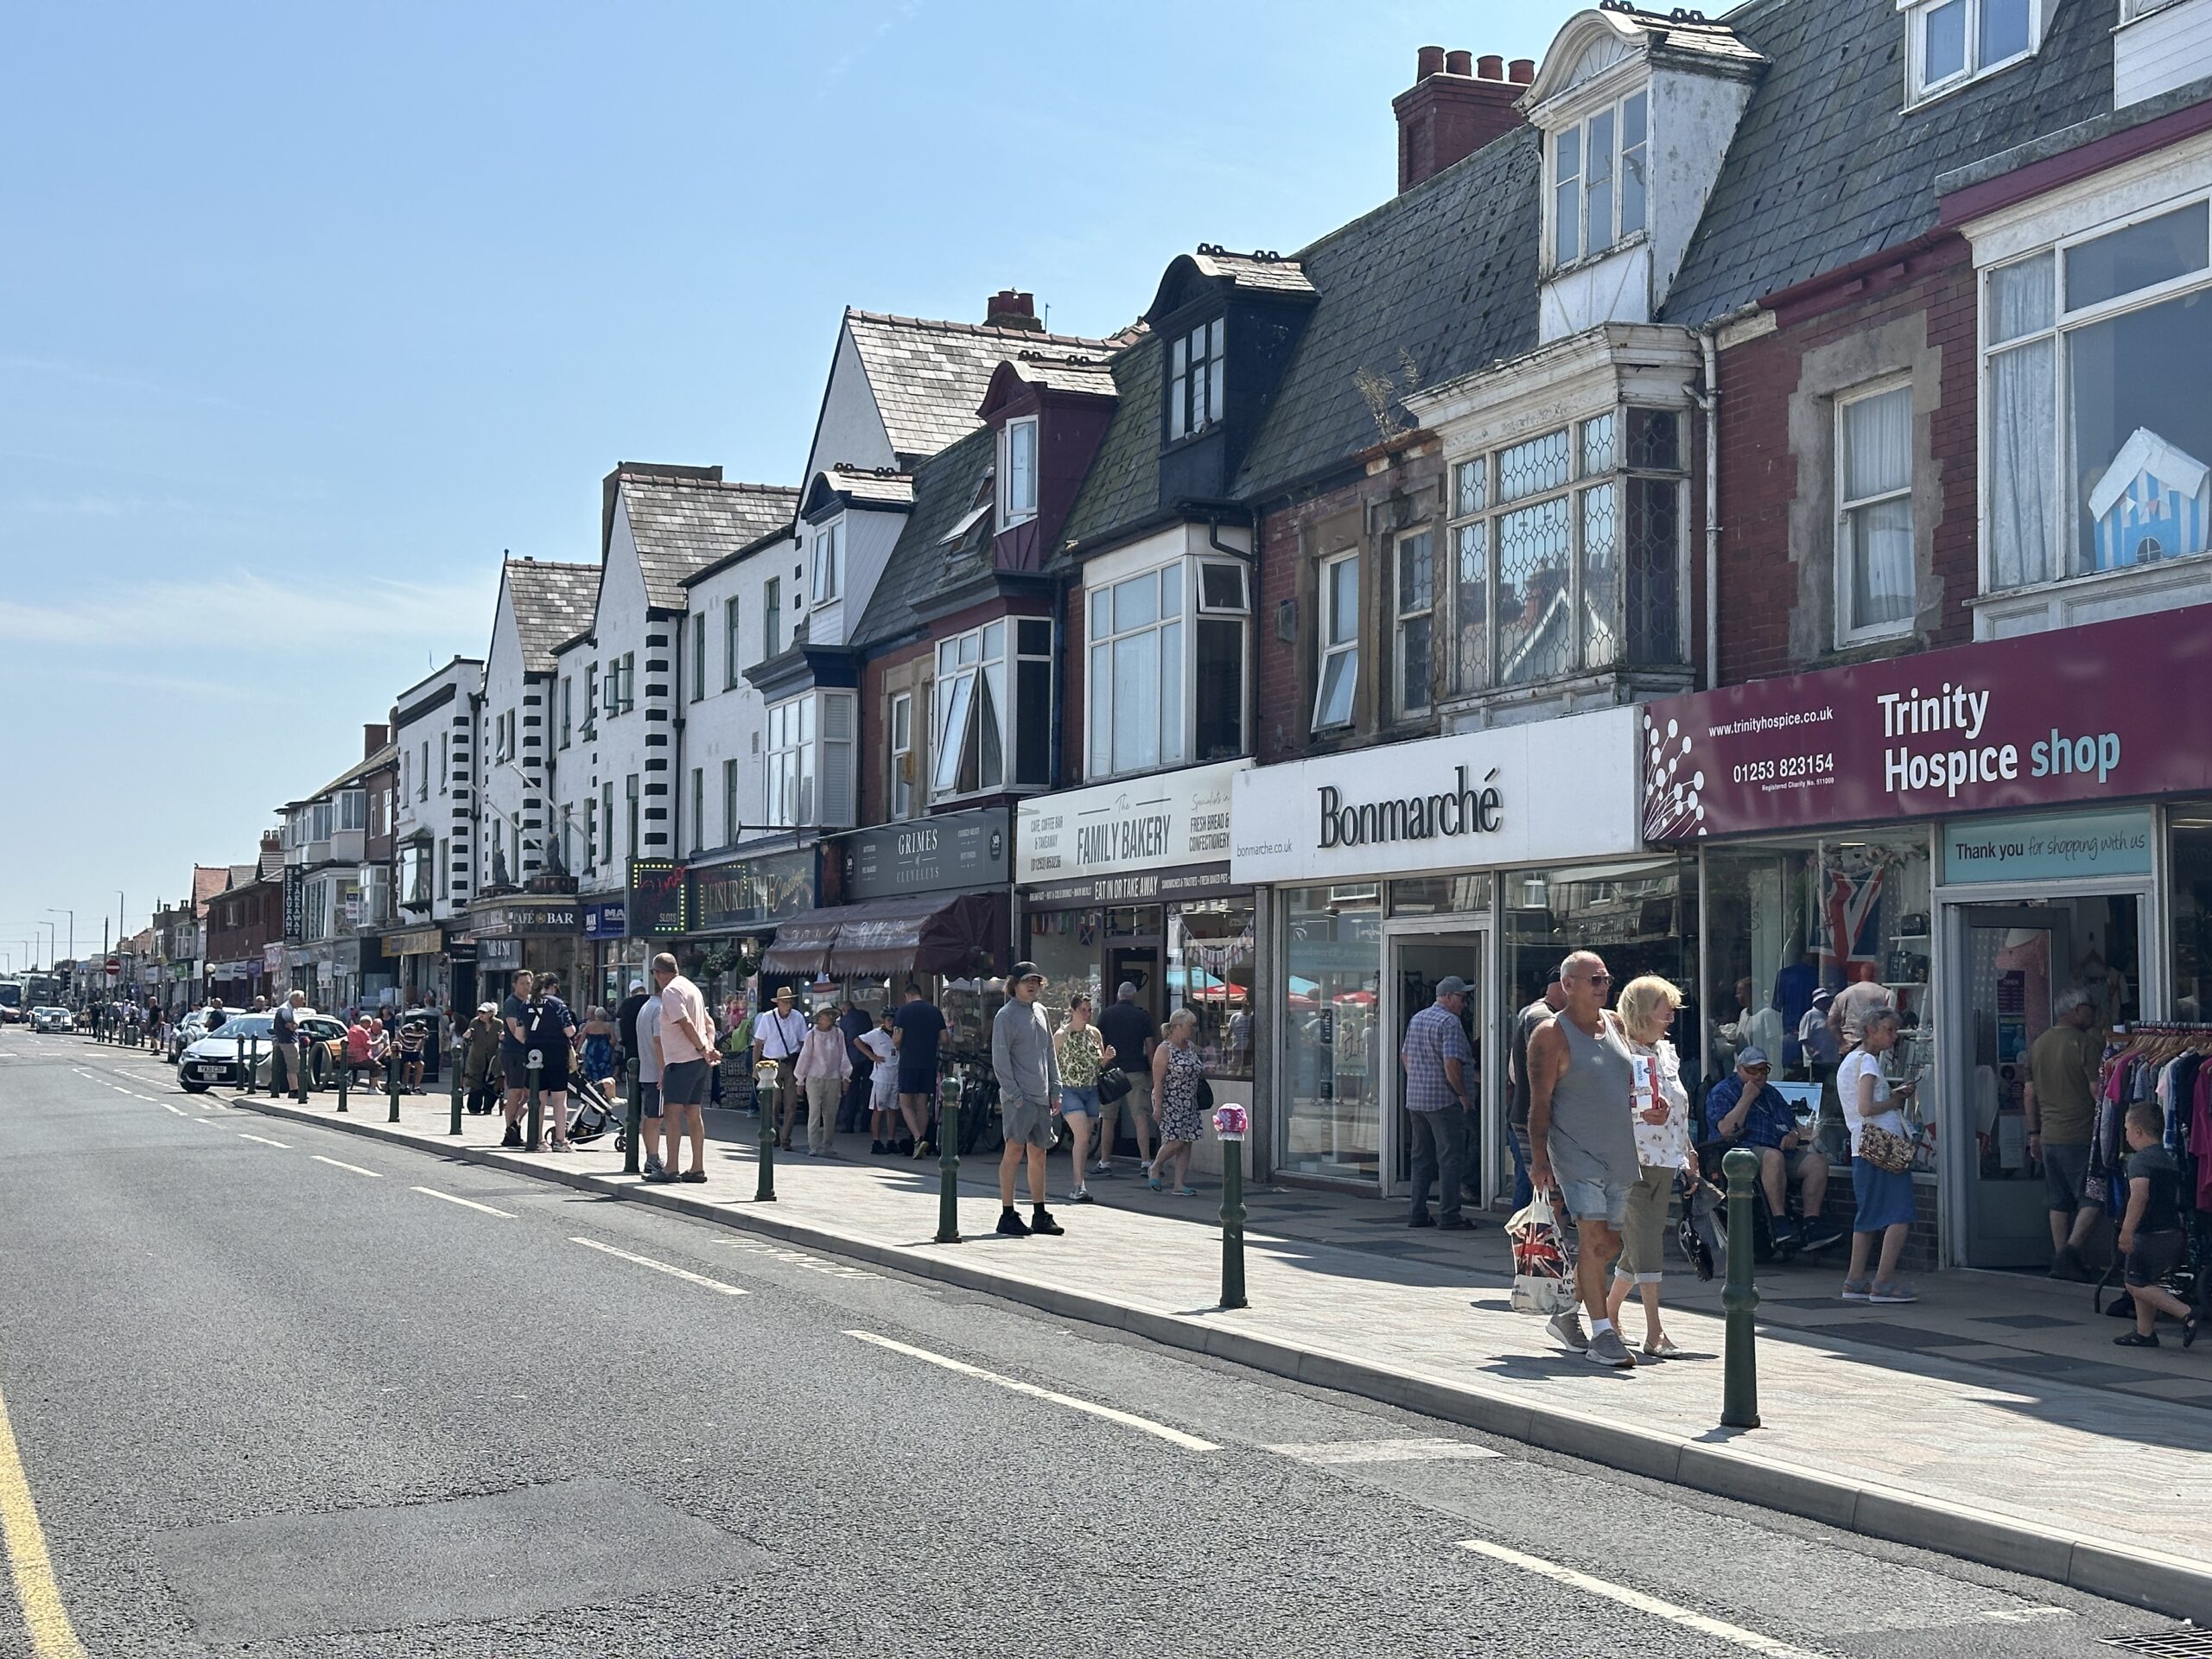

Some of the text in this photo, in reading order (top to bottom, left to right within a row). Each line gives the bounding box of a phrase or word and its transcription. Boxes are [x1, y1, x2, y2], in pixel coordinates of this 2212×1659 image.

[1708, 706, 1834, 737] www.trinityhospice.co.uk
[1877, 683, 1989, 739] Trinity
[1733, 753, 1834, 783] 01253 823154
[1885, 728, 2120, 798] Hospice shop
[1761, 782, 1787, 791] Registered
[1116, 793, 1130, 812] The
[1316, 764, 1503, 849] Bonmarché
[1041, 817, 1054, 831] COFFEE
[1190, 812, 1230, 833] FRESH BREAD &
[898, 828, 938, 855] GRIMES
[1038, 834, 1058, 849] TAKEAWAY
[1077, 814, 1171, 865] FAMILY BAKERY
[1189, 832, 1230, 852] CONFECTIONERY
[1237, 838, 1293, 857] bonmarche.co.uk
[1956, 830, 2145, 861] Thank you for shopping with us
[1095, 875, 1158, 900] EAT IN OR TAKE AWAY
[512, 910, 574, 925] CAFÉ BAR
[659, 912, 677, 923] SLOTS
[528, 1007, 543, 1031] 7
